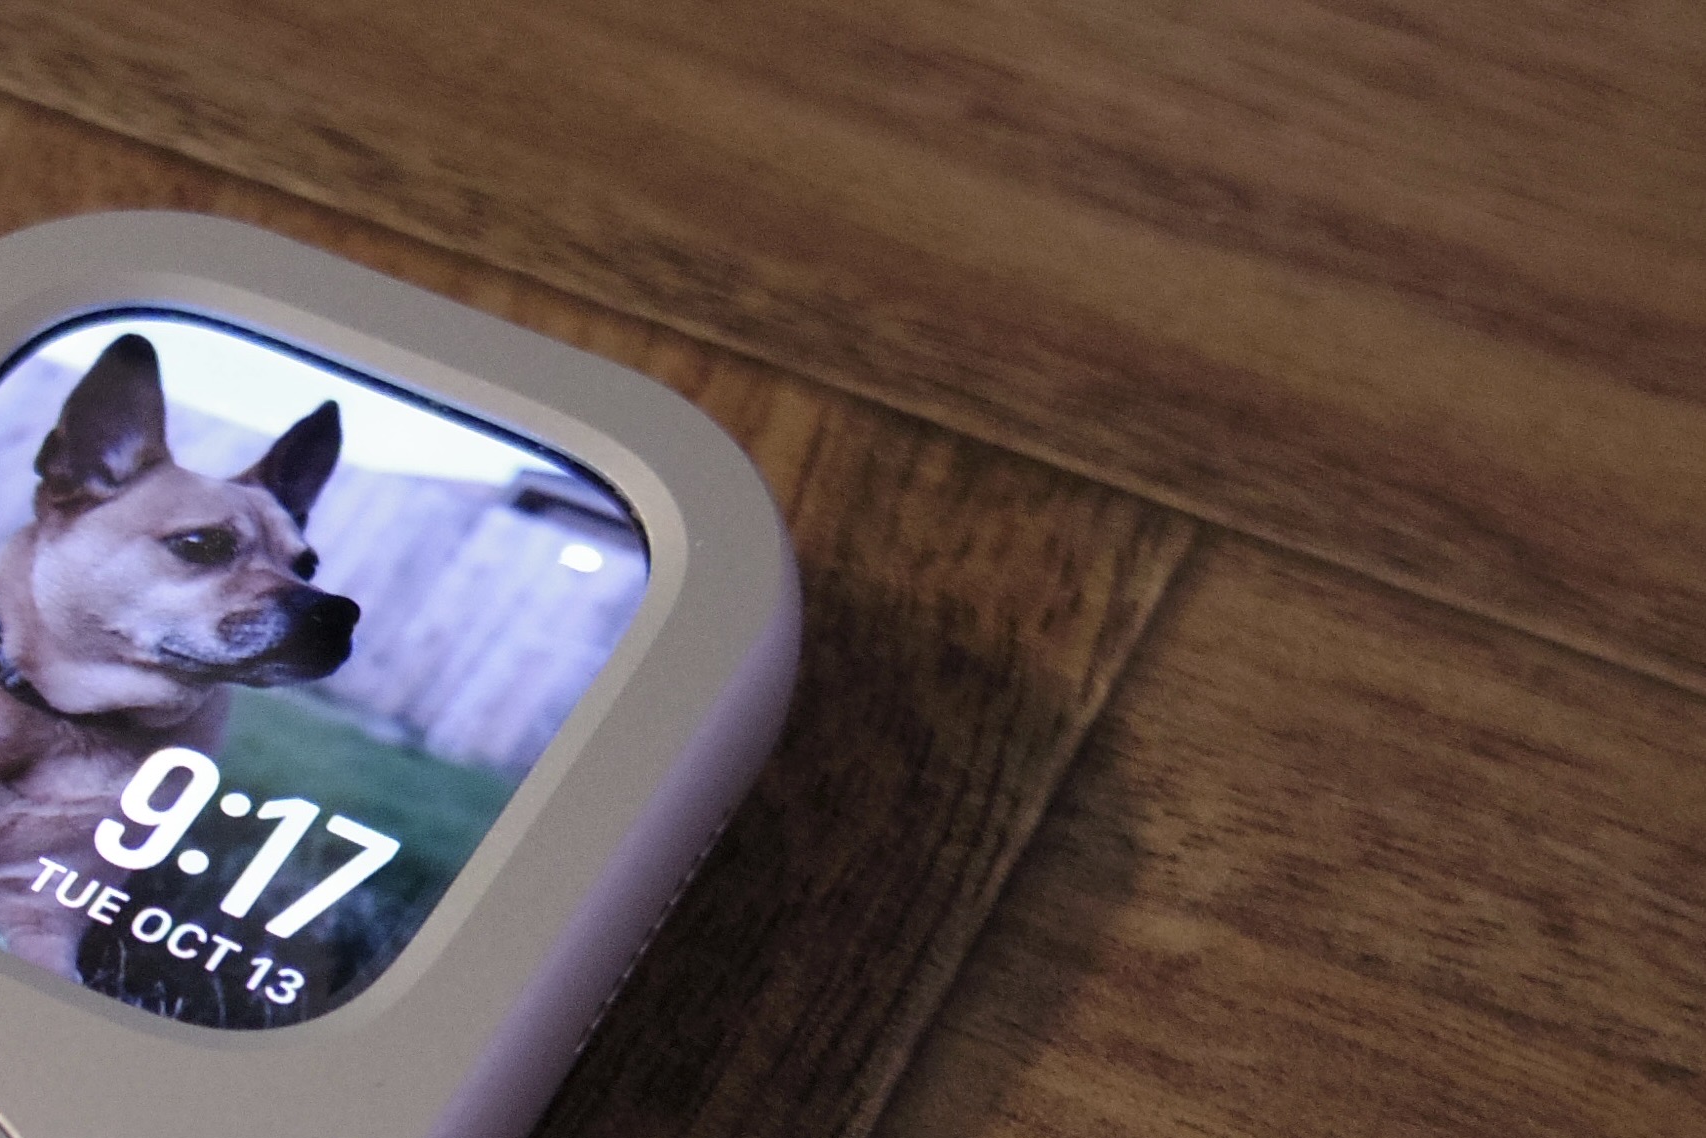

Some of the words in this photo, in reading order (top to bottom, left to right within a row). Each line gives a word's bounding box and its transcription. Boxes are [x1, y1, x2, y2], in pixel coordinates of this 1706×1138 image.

[94, 746, 401, 939] 9:17
[29, 856, 131, 926] TUE
[131, 906, 243, 973] OCT
[245, 956, 306, 1006] 13
